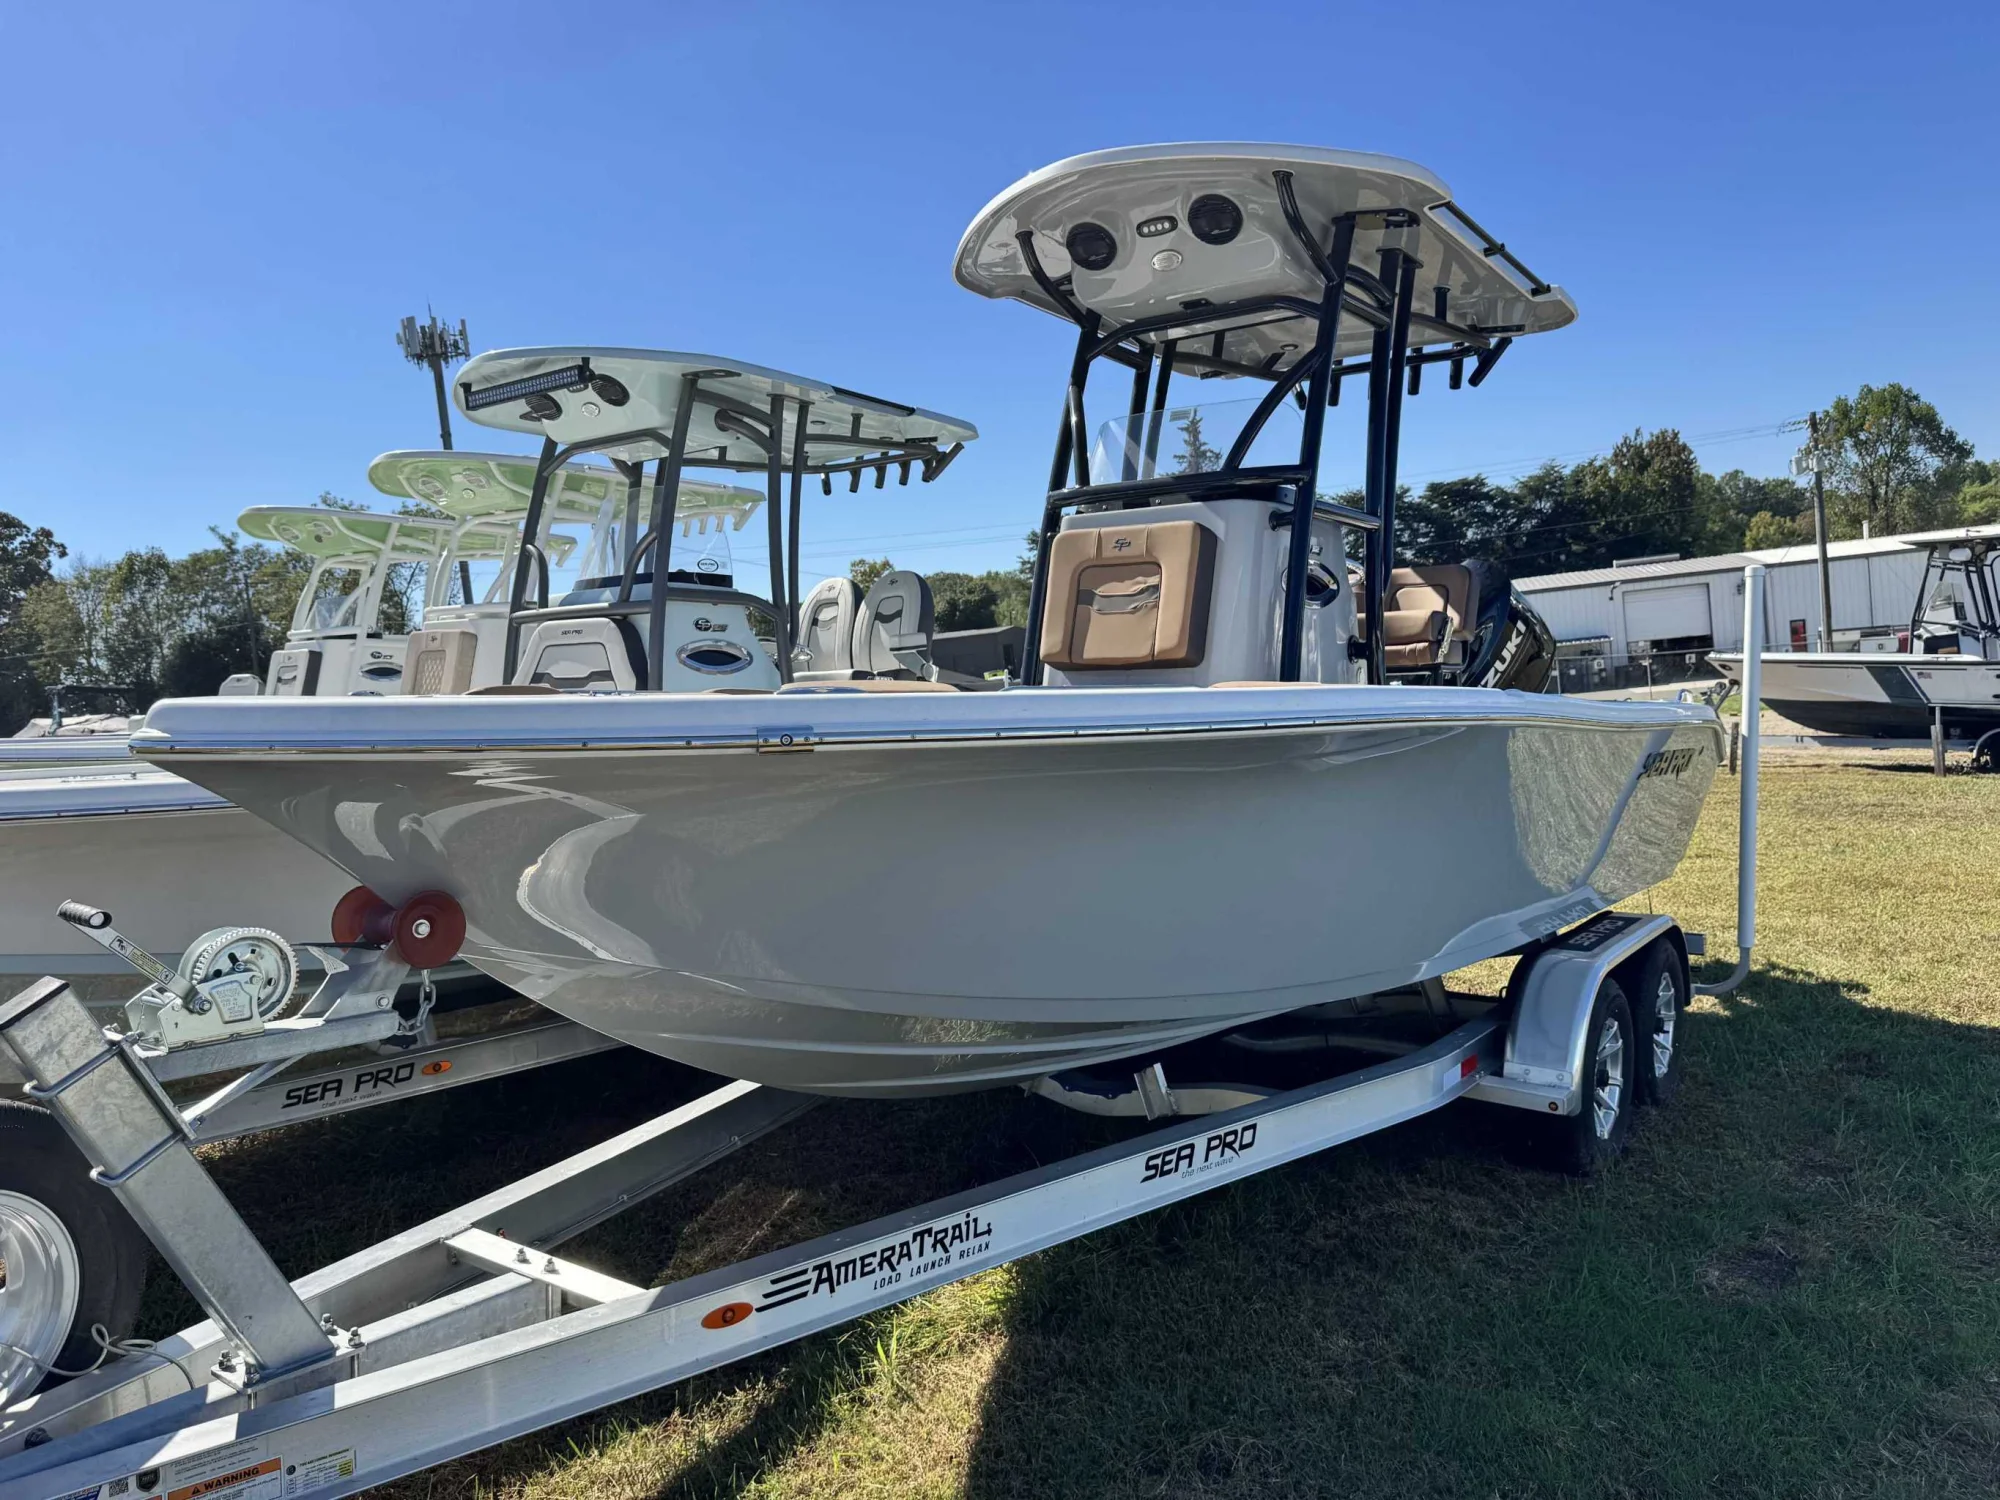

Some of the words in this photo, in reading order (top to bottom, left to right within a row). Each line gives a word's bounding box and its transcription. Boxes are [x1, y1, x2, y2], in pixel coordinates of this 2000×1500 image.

[1478, 619, 1527, 688] ZUKI
[281, 1078, 343, 1109] SEA
[354, 1062, 416, 1093] PRO
[1140, 1142, 1196, 1184] SEA
[1203, 1122, 1258, 1163] PRO
[1181, 1168, 1195, 1179] the
[1196, 1161, 1214, 1174] next
[1214, 1156, 1234, 1168] wave
[873, 1272, 901, 1291] LOAD
[909, 1254, 952, 1278] LAUNCH
[958, 1240, 991, 1260] RELAX
[203, 1466, 261, 1491] WARNING
